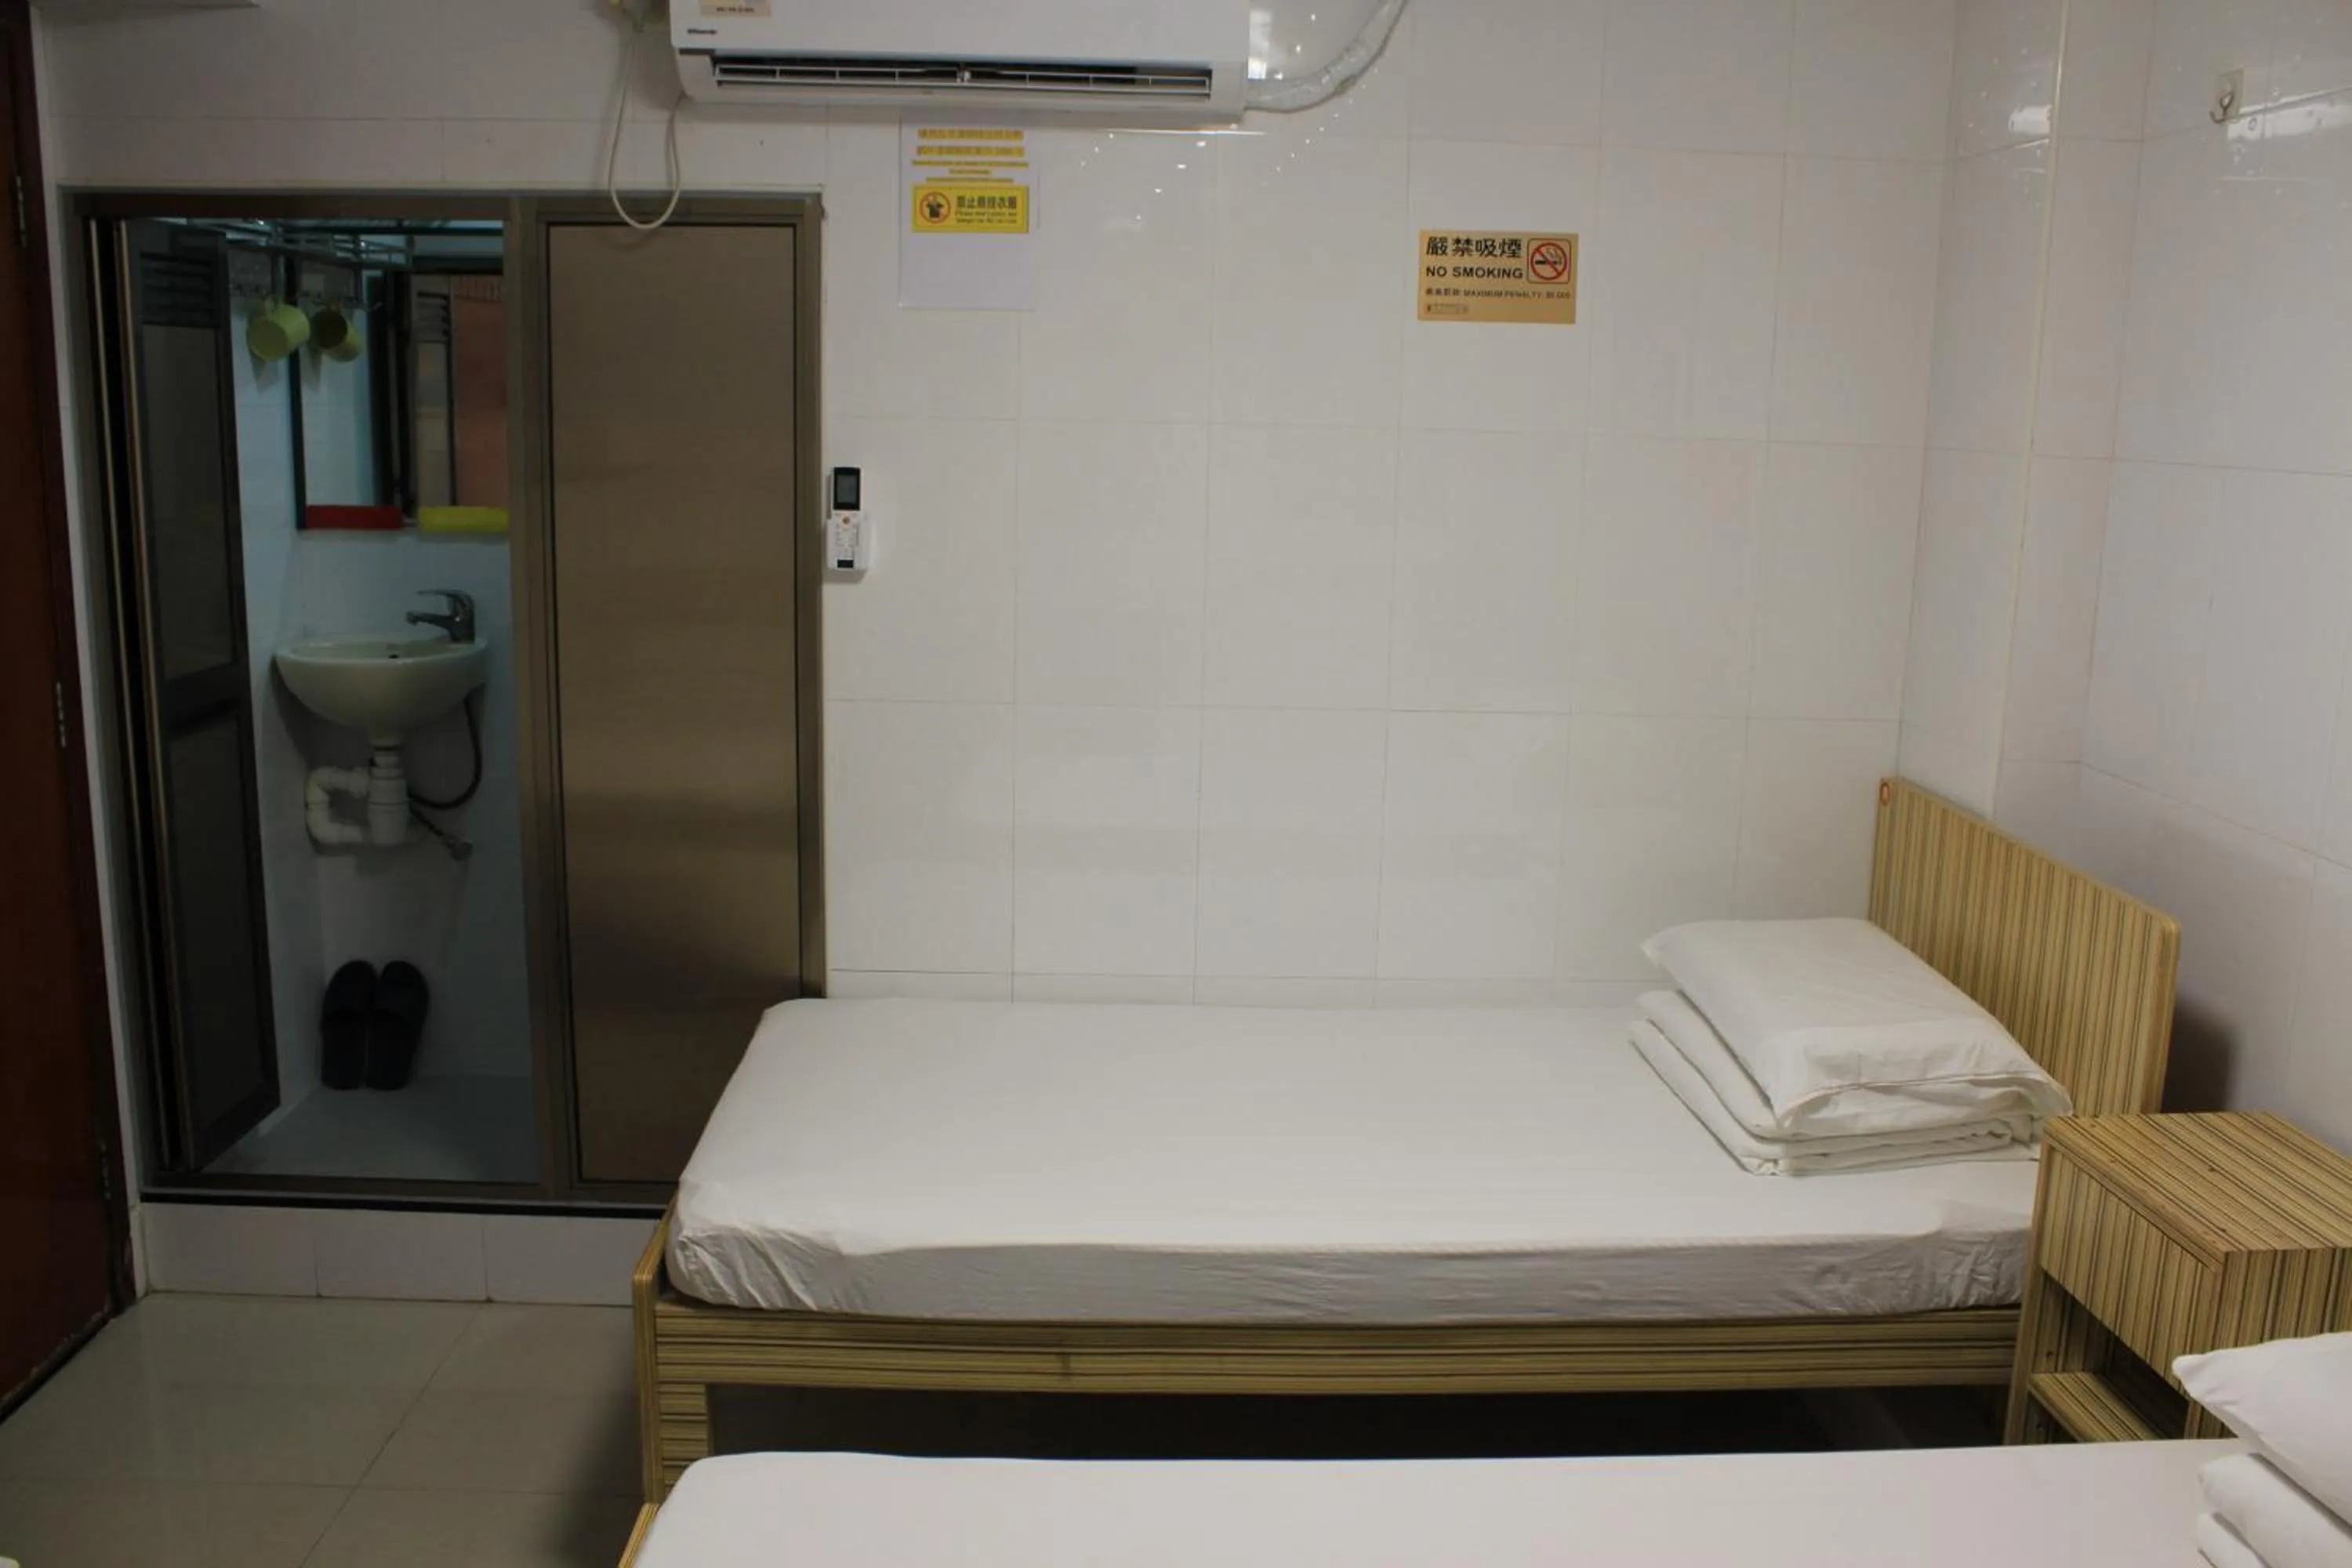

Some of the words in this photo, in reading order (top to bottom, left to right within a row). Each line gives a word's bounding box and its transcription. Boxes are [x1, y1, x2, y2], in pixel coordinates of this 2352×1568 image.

[1425, 236, 1523, 259] 嚴禁吸煙
[1425, 266, 1447, 278] NO
[1452, 266, 1523, 279] SMOKING
[1463, 288, 1503, 297] MAXIMUM
